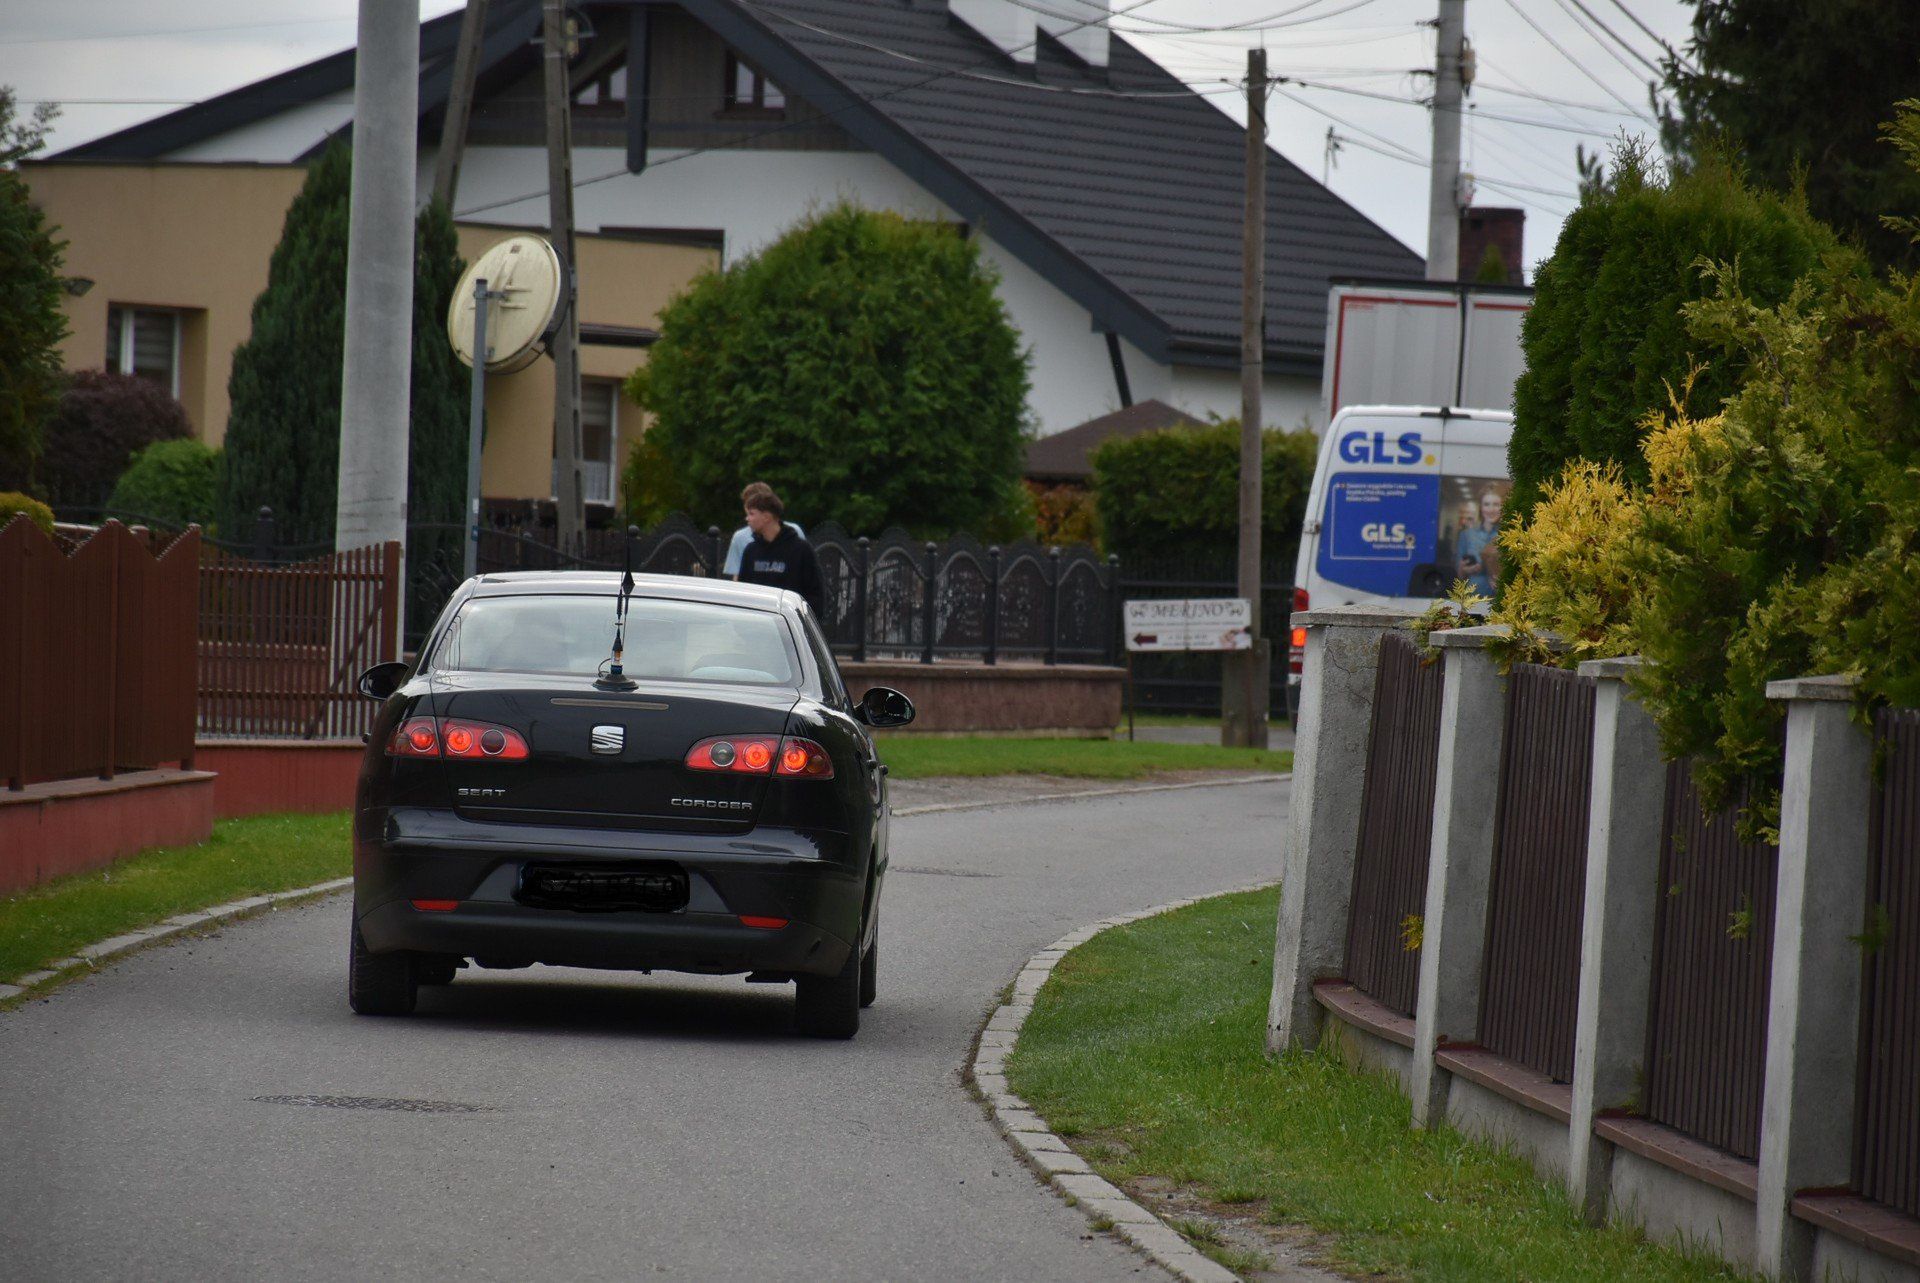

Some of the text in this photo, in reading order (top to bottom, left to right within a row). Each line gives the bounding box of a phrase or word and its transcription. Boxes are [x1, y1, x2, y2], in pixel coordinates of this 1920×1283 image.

[1151, 603, 1224, 618] MERINO
[457, 788, 506, 797] SEAT
[670, 798, 753, 810] CORDOBA
